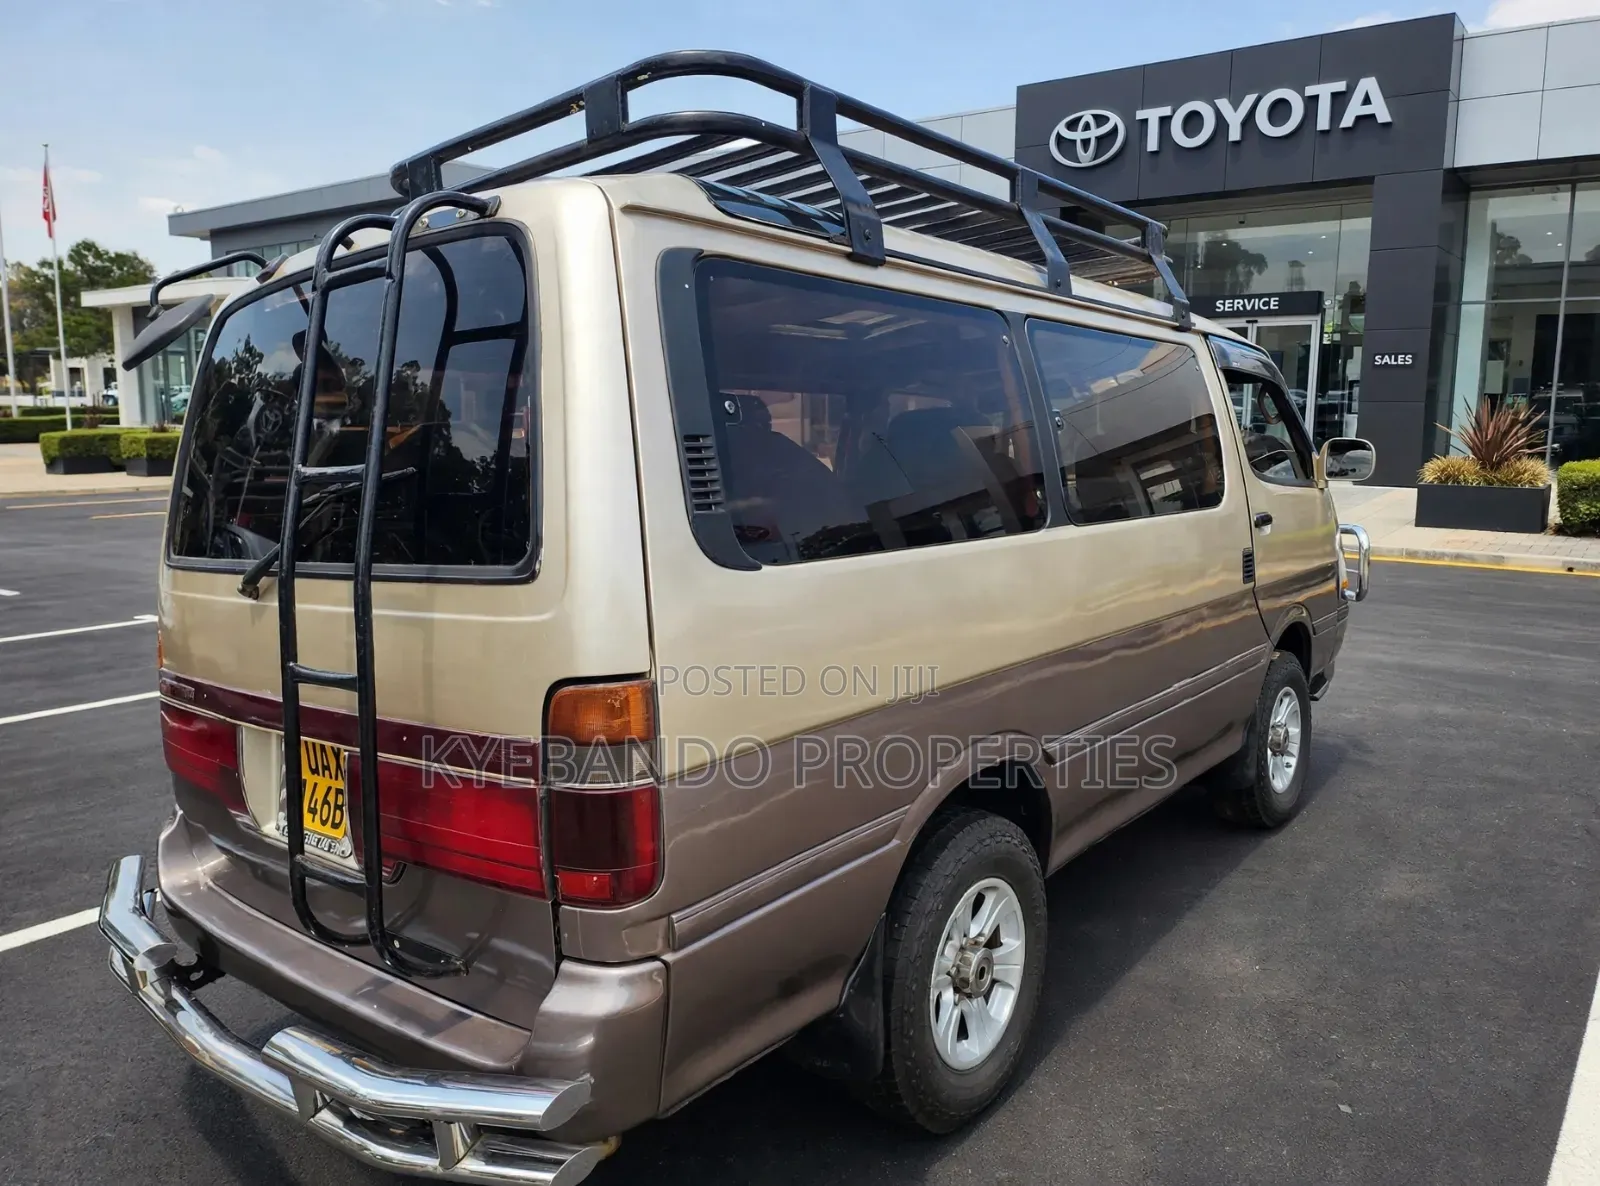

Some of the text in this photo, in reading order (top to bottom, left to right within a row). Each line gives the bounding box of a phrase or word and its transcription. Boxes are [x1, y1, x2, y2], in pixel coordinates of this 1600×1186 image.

[1136, 76, 1392, 152] TOYOTA
[1215, 297, 1279, 312] SERVICE
[1374, 354, 1413, 366] SALES
